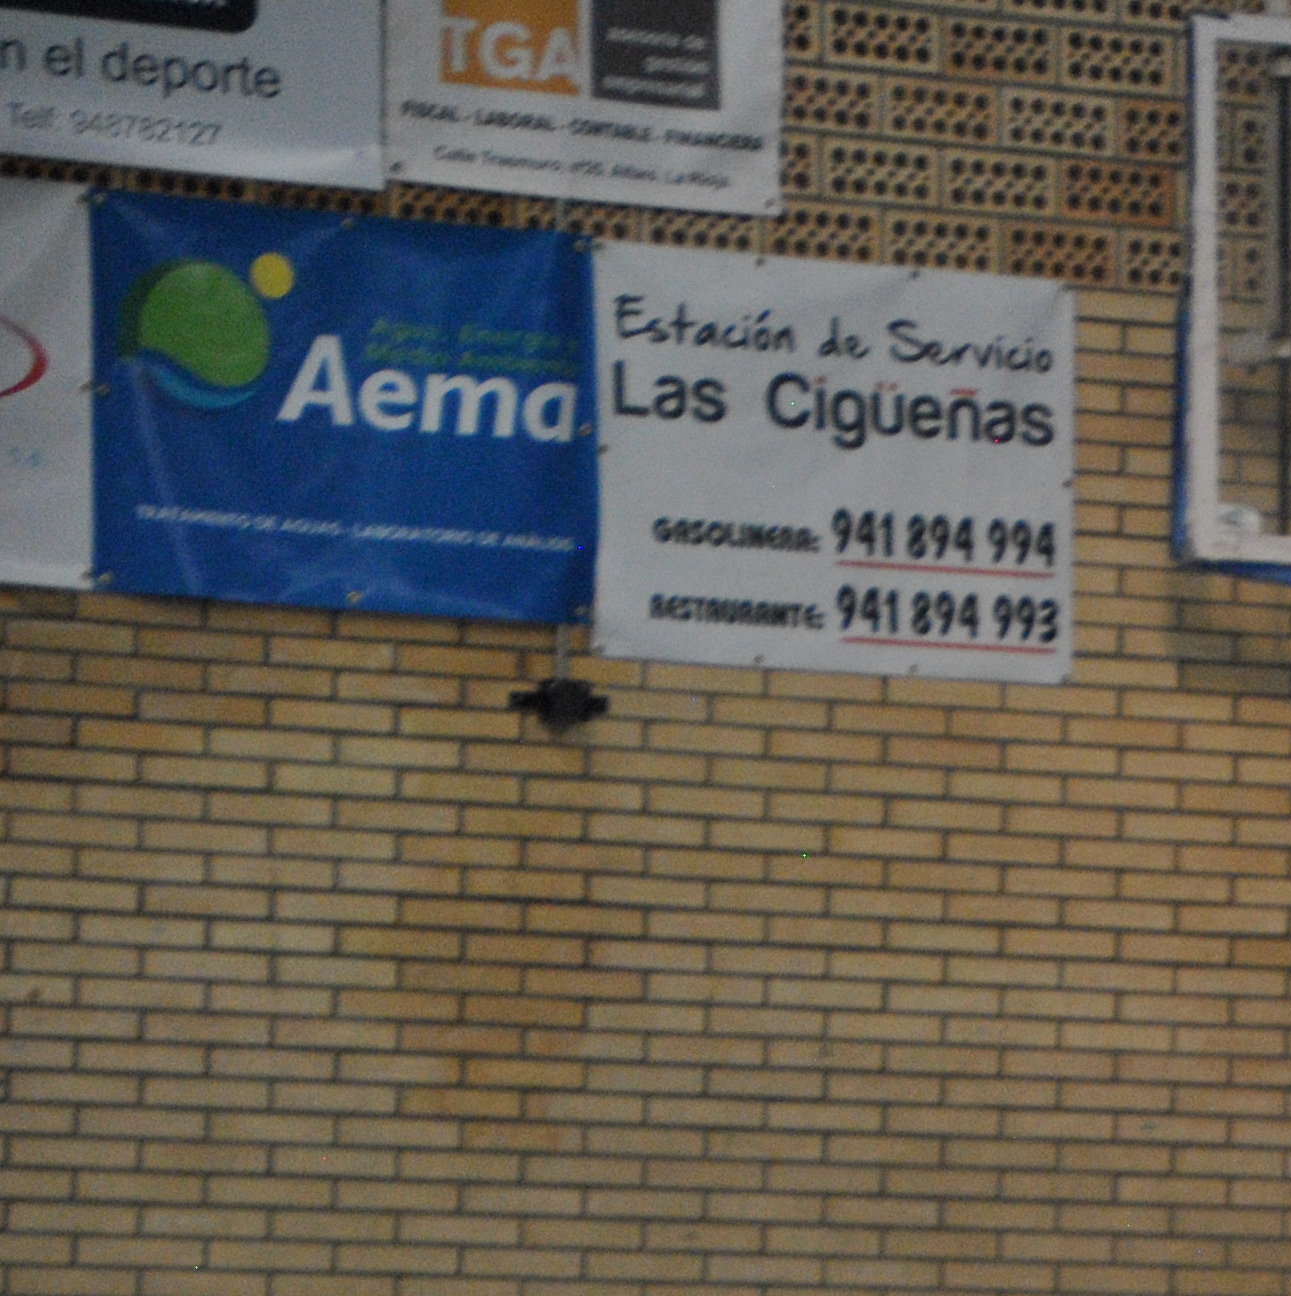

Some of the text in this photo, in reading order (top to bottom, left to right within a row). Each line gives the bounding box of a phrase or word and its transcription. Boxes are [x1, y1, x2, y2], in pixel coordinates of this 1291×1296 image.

[44, 37, 84, 78] el
[101, 41, 281, 99] deporte
[439, 16, 580, 81] TGA
[613, 294, 1055, 374] Estación de Servicio
[276, 333, 580, 443] Aema
[610, 358, 1055, 450] Las Cigüeñas
[830, 507, 897, 558] 941
[906, 513, 975, 563] 894
[987, 517, 1058, 568] 994
[836, 583, 901, 635] 941
[911, 590, 980, 639] 894
[992, 594, 1060, 644] 993
